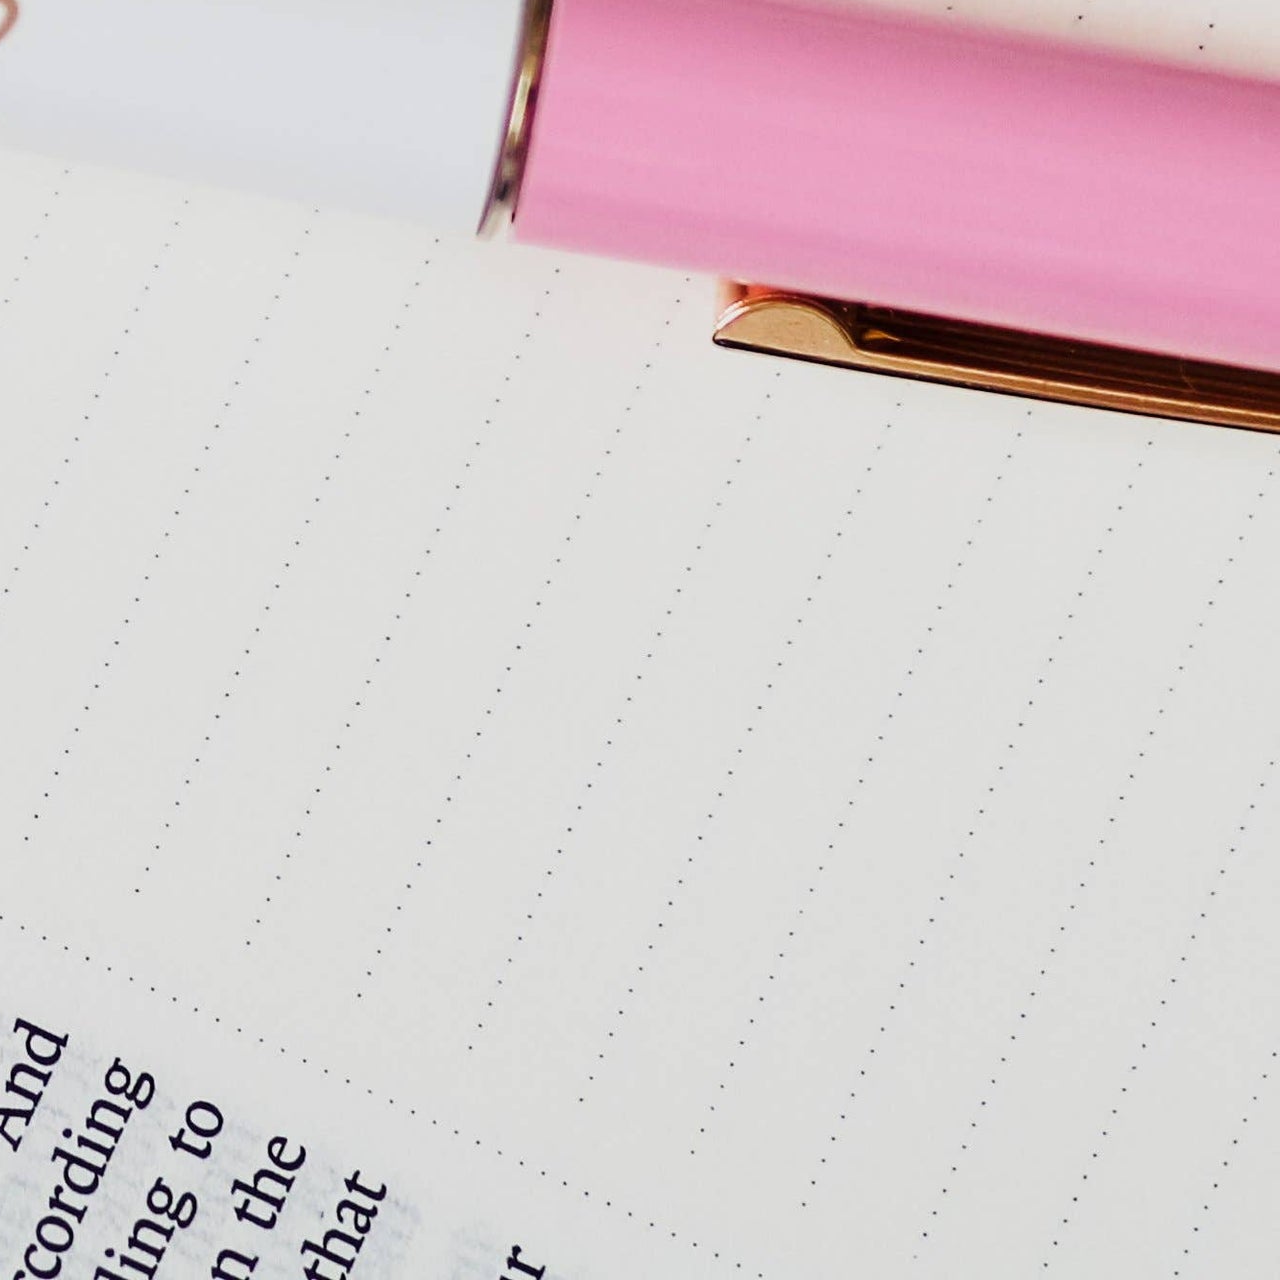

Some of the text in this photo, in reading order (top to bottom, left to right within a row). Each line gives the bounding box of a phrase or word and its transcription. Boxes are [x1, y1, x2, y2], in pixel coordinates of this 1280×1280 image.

[12, 1055, 157, 1280] cording
[167, 1099, 225, 1161] to
[230, 1135, 308, 1231] the
